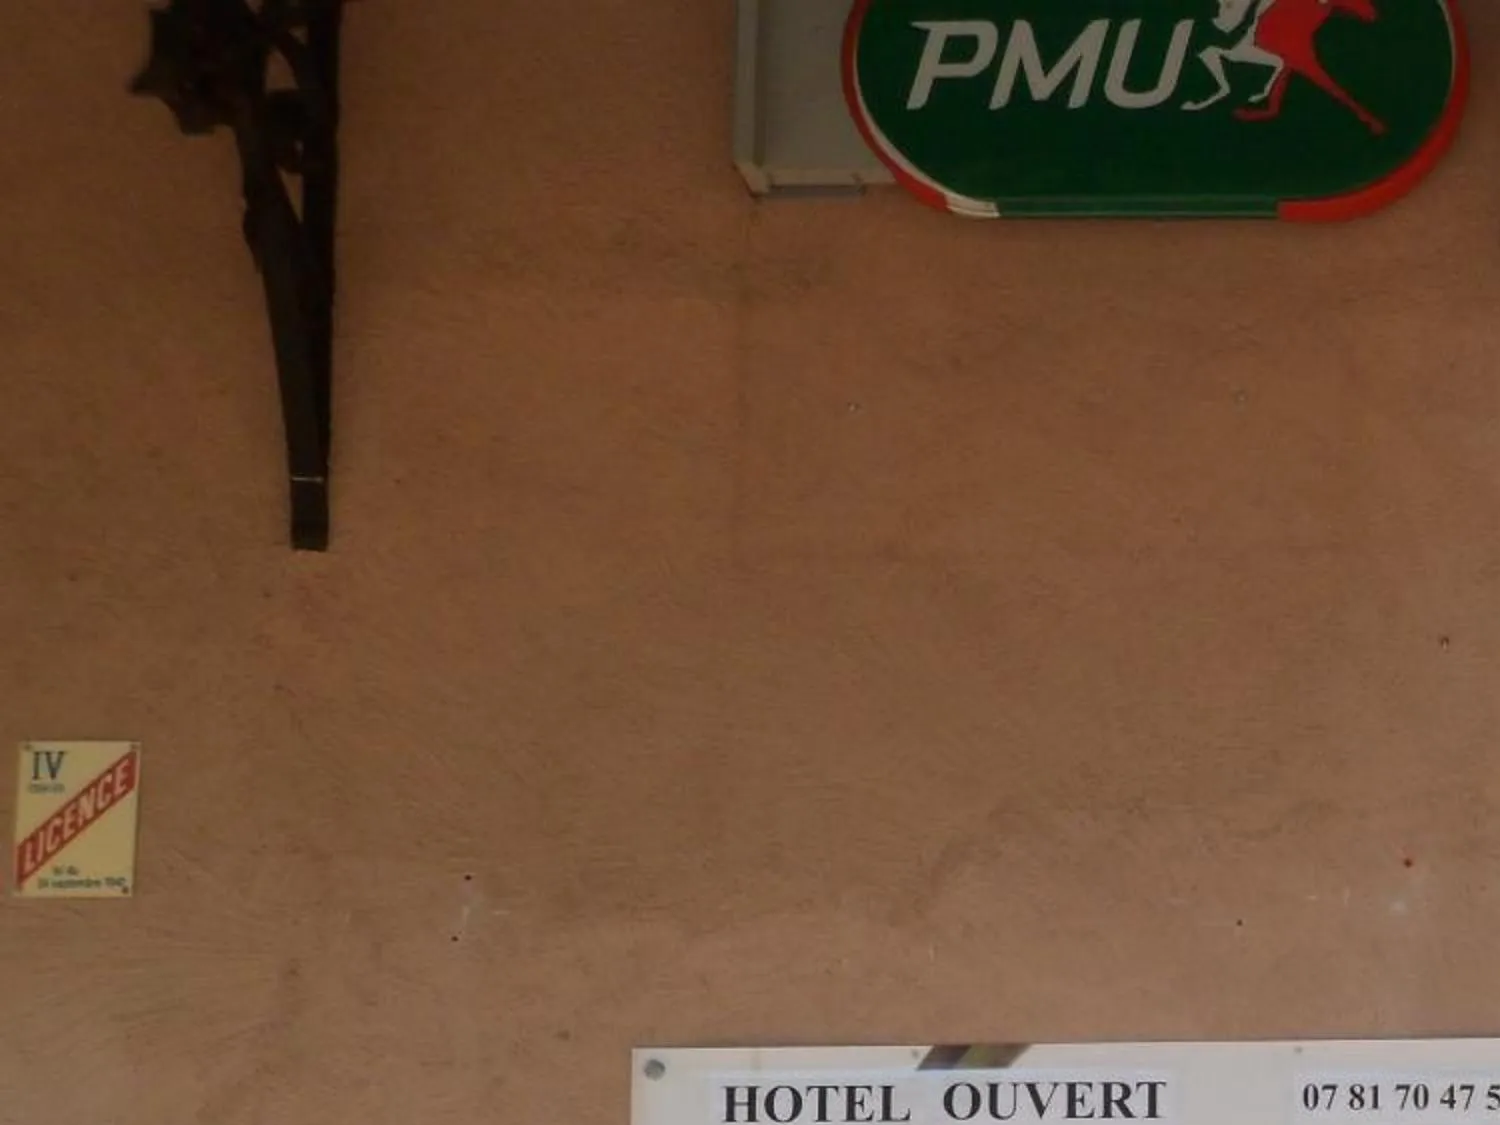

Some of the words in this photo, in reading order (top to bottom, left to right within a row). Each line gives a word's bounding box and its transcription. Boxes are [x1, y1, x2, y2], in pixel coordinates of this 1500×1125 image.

[906, 19, 1194, 111] PMU
[32, 751, 65, 780] IV
[22, 758, 130, 875] LICENCE
[723, 1084, 911, 1123] HOTEL
[943, 1081, 1167, 1121] OUVERT
[1303, 1084, 1338, 1111] 07
[1349, 1084, 1381, 1111] 81
[1395, 1084, 1430, 1111] 70
[1440, 1084, 1475, 1111] 47
